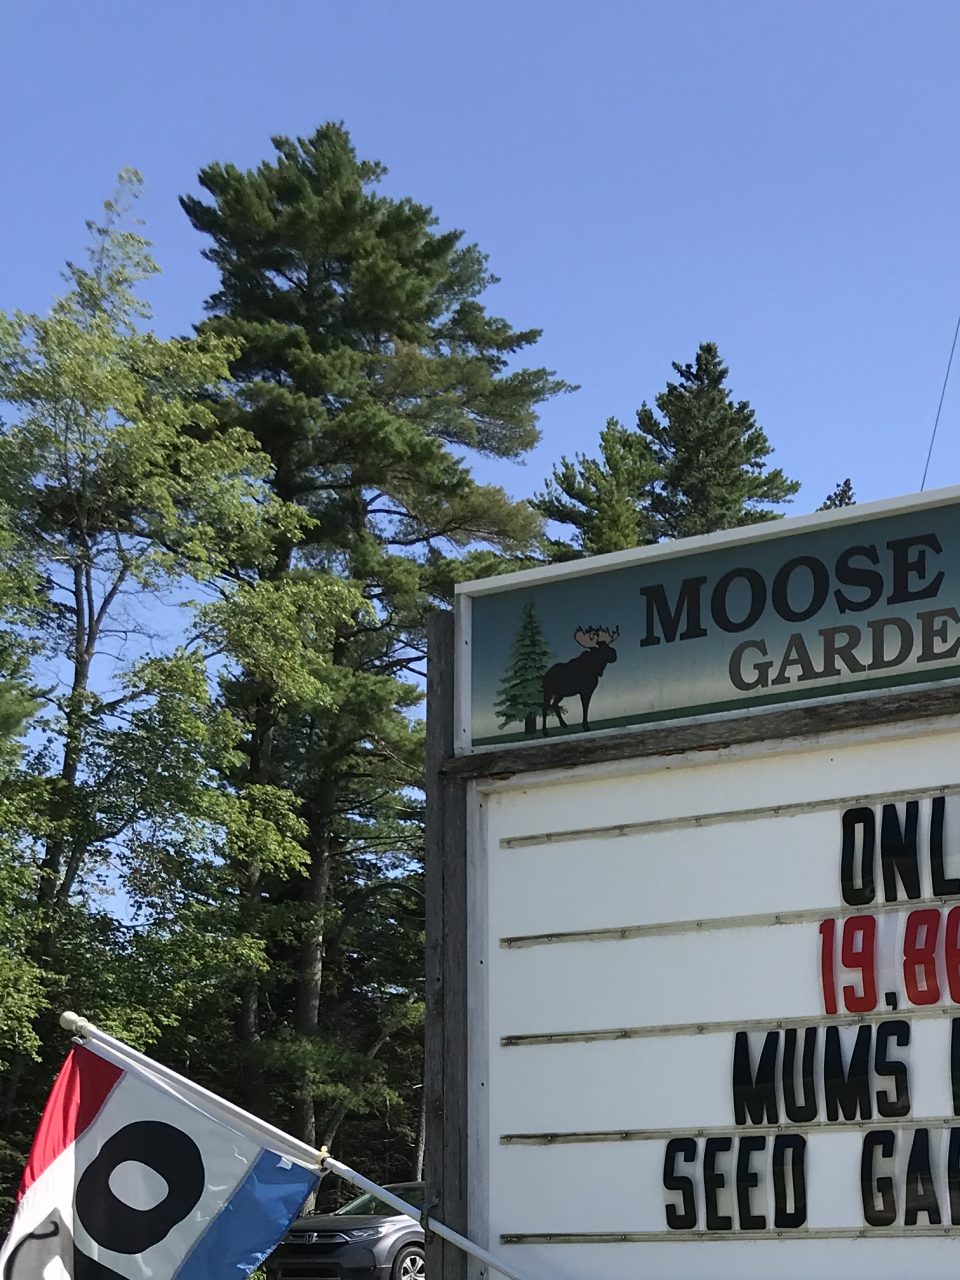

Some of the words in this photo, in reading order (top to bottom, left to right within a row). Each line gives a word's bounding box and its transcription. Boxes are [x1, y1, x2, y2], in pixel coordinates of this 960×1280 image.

[639, 534, 945, 647] MOOSE
[732, 1020, 912, 1126] MUMS
[663, 1133, 808, 1231] SEED
